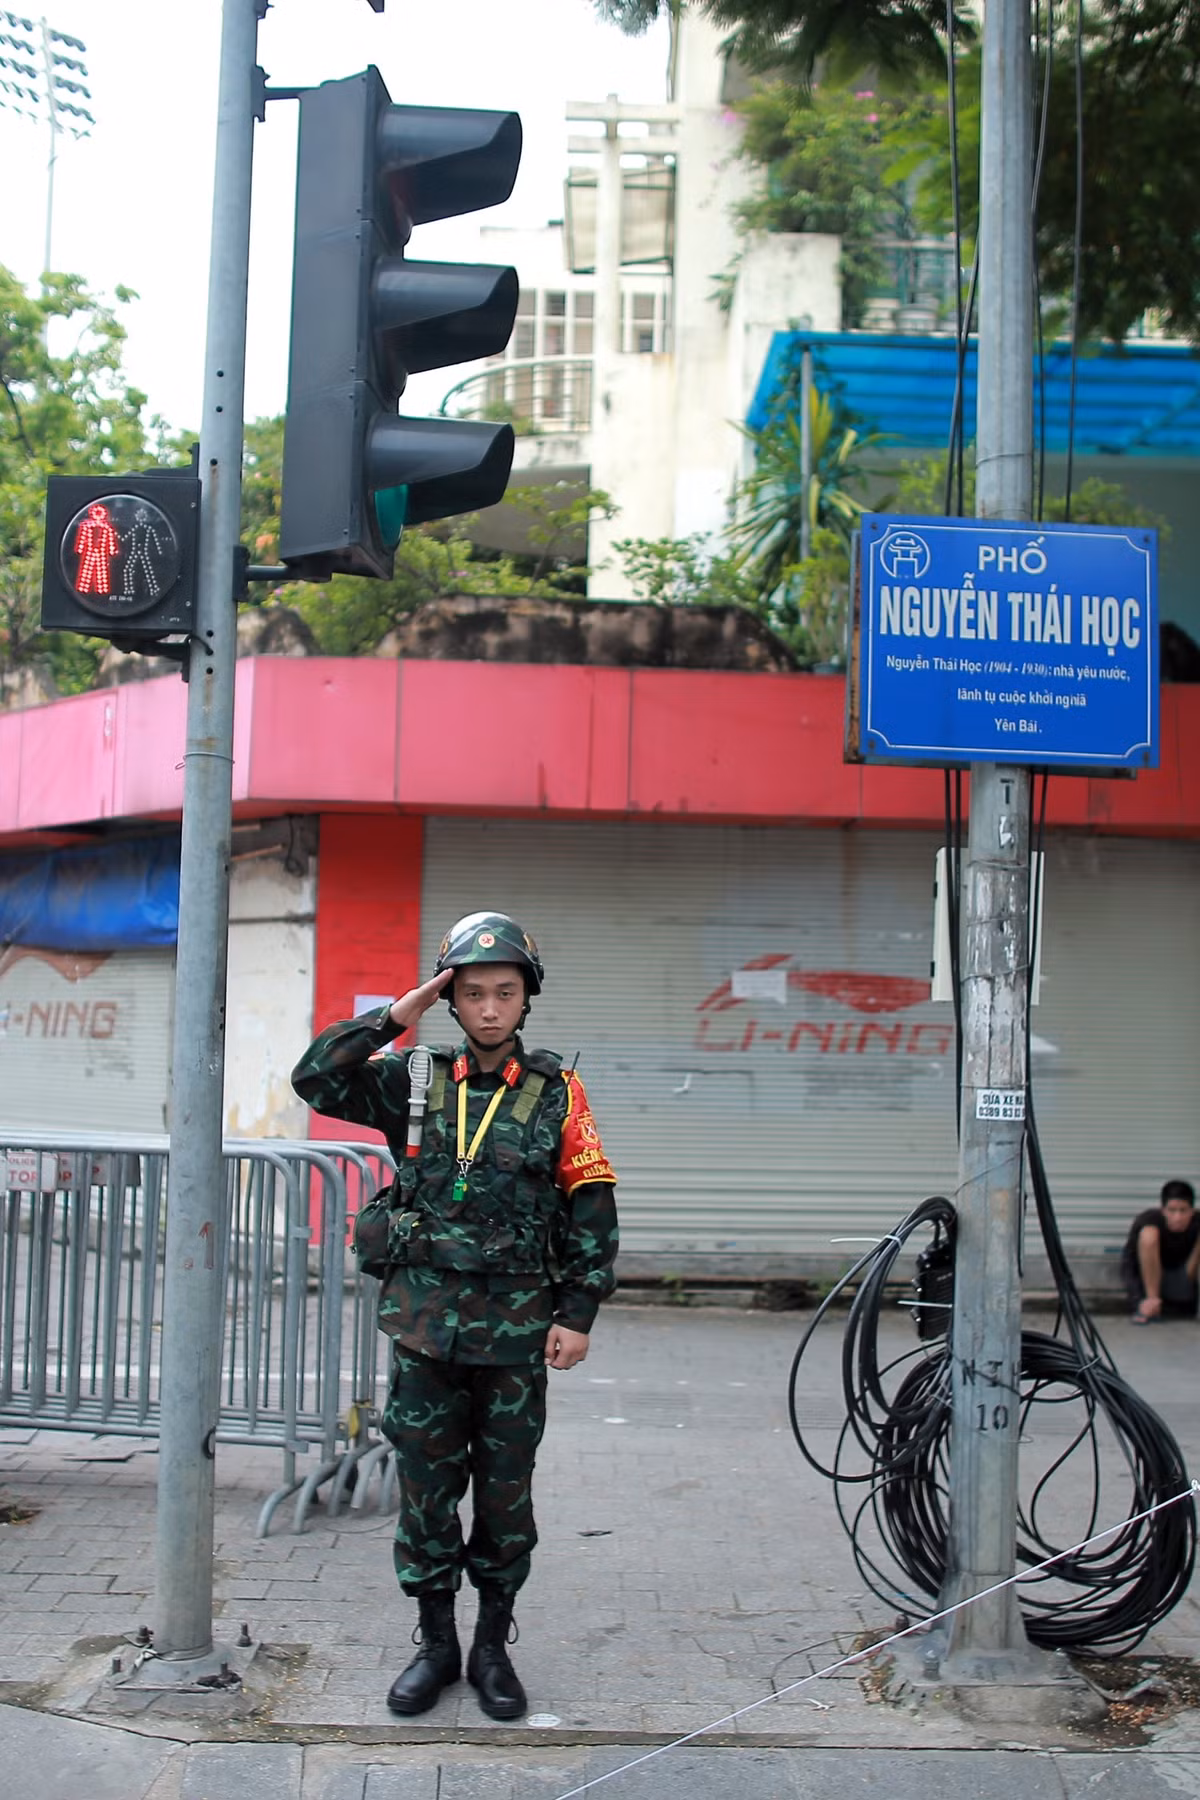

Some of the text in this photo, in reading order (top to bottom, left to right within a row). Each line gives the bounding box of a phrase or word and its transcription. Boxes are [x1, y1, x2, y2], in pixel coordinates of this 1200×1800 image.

[978, 536, 1048, 574] PHỐ
[880, 572, 1141, 656] NGUYỄN THÁI HỌC
[886, 654, 929, 672] Nguyễn
[932, 657, 957, 671] Thái
[959, 659, 982, 675] Học
[1053, 664, 1074, 677] nhà
[1076, 665, 1097, 681] yêu
[957, 687, 982, 701] lãnh
[984, 689, 996, 705] tụ
[998, 690, 1026, 706] cuộc
[1029, 689, 1053, 705] khởi
[994, 717, 1016, 732] Yên
[976, 1403, 1009, 1431] 10
